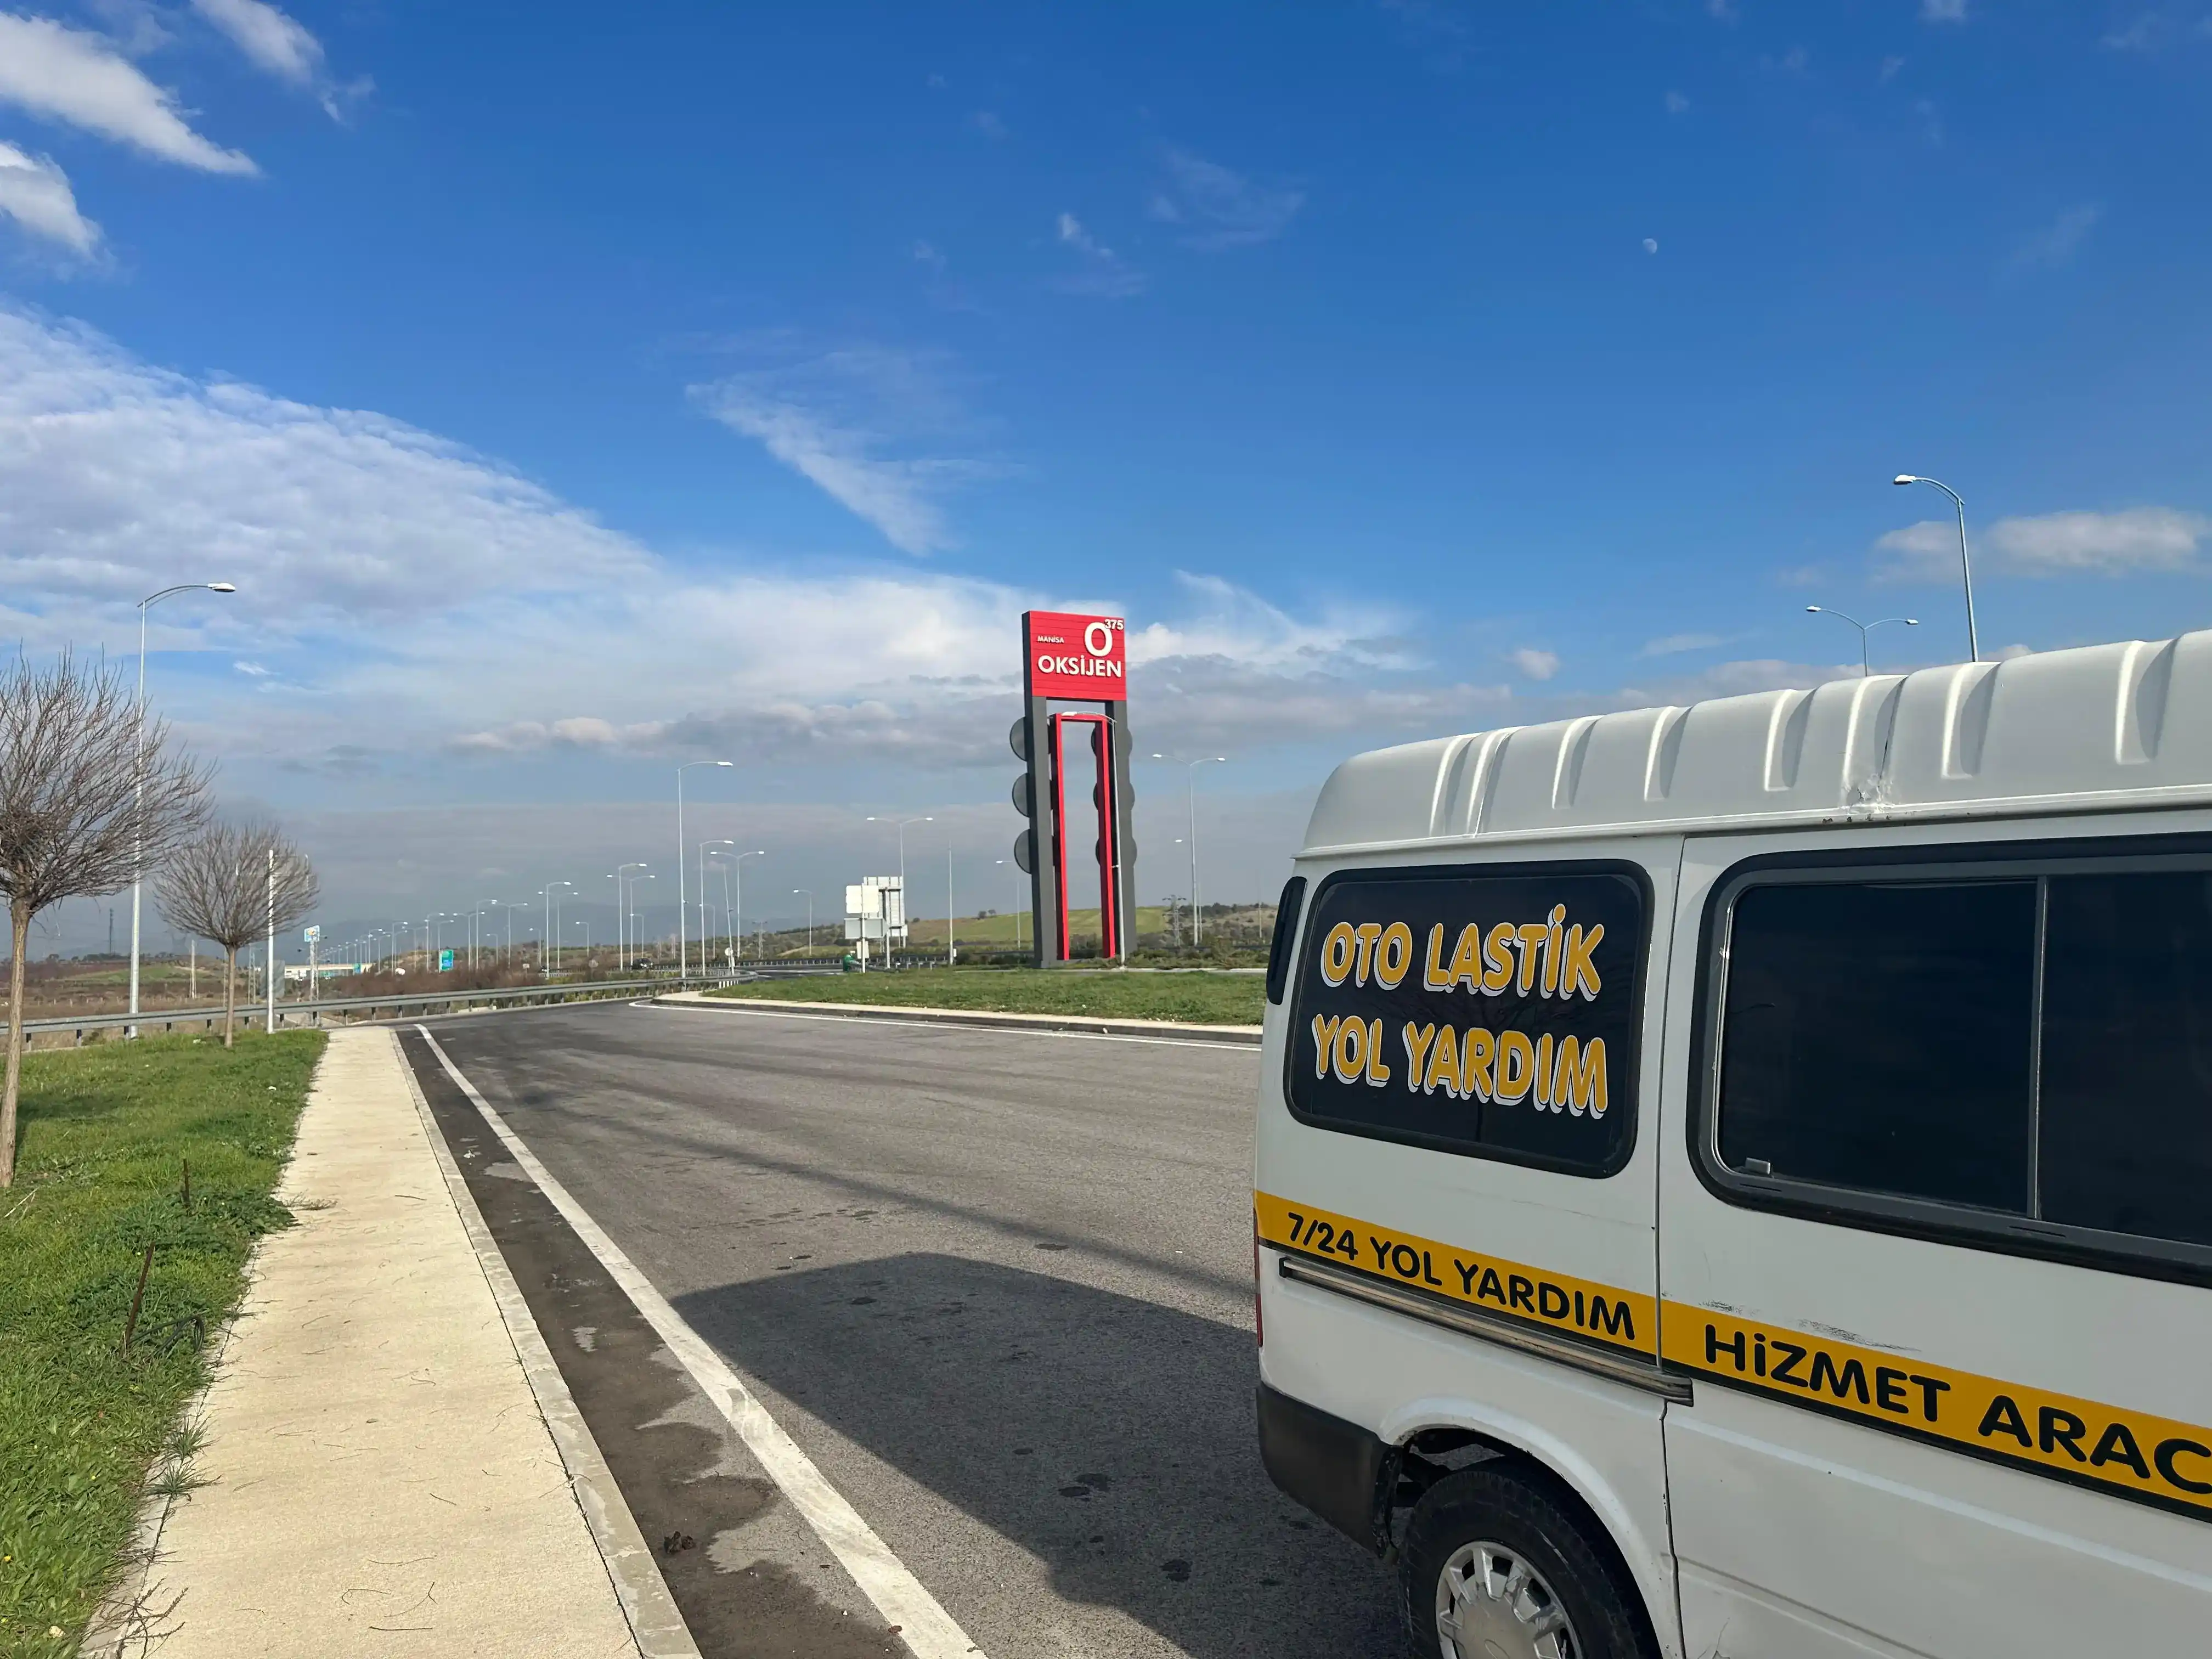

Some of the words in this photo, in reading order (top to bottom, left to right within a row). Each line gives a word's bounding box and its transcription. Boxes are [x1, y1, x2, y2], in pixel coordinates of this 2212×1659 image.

[1038, 654, 1122, 678] OKSİJEN
[1105, 619, 1124, 630] 375
[1321, 921, 1413, 991] OTO
[1423, 903, 1604, 1002] LASTİK
[1312, 1013, 1390, 1087] YOL
[1402, 1020, 1608, 1119] YARDIM
[1288, 1212, 1358, 1261] 7/24
[1370, 1236, 1443, 1286] YOL
[1454, 1259, 1635, 1341] YARDIM
